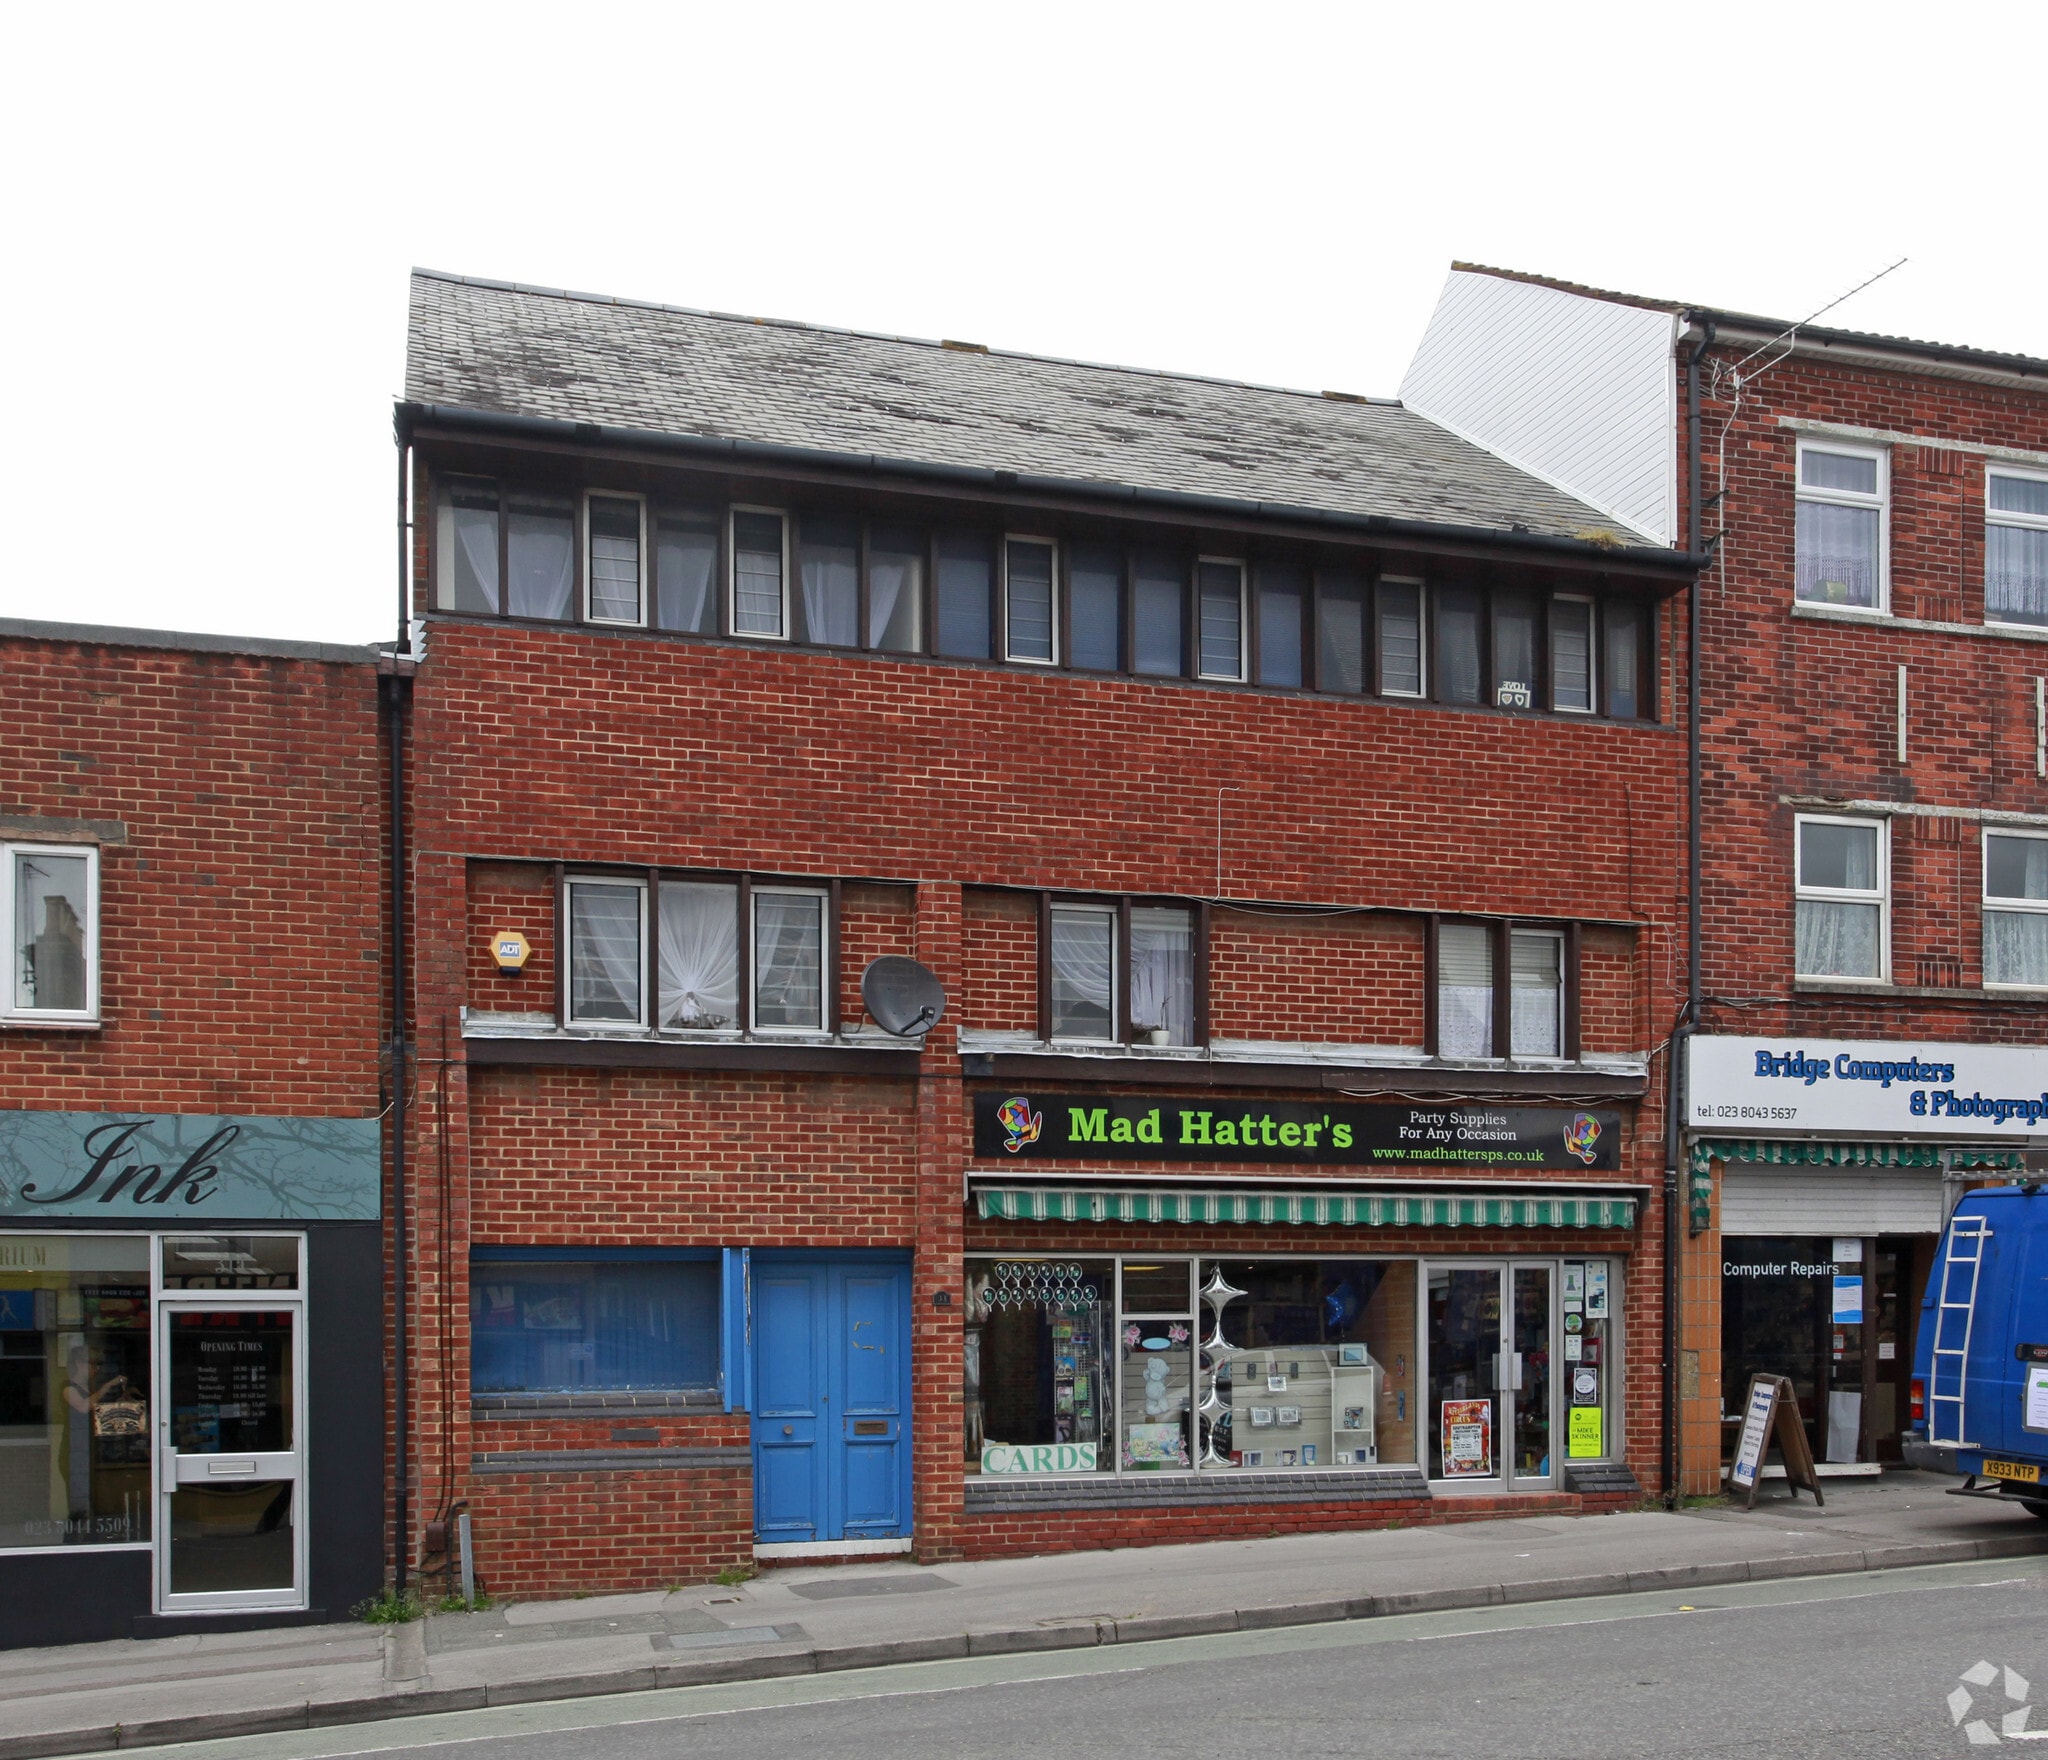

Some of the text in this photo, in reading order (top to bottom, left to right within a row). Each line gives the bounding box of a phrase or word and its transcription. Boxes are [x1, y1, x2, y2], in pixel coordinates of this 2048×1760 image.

[500, 944, 520, 954] ADT
[1754, 1050, 1954, 1088] Bridge Computers
[1909, 1090, 1927, 1116] &
[1410, 1111, 1507, 1127] Party Supplies
[1697, 1105, 1797, 1120] tel: 023 8043 5637
[1068, 1107, 1353, 1148] Mad Hatter's
[1399, 1126, 1517, 1142] For Any Occasion
[20, 1120, 241, 1204] Ink
[1372, 1147, 1544, 1164] www.madhattersps.co.uk
[1723, 1261, 1840, 1279] Computer Repairs
[983, 1444, 1095, 1473] CARDS
[1987, 1461, 2034, 1479] X933 NTP
